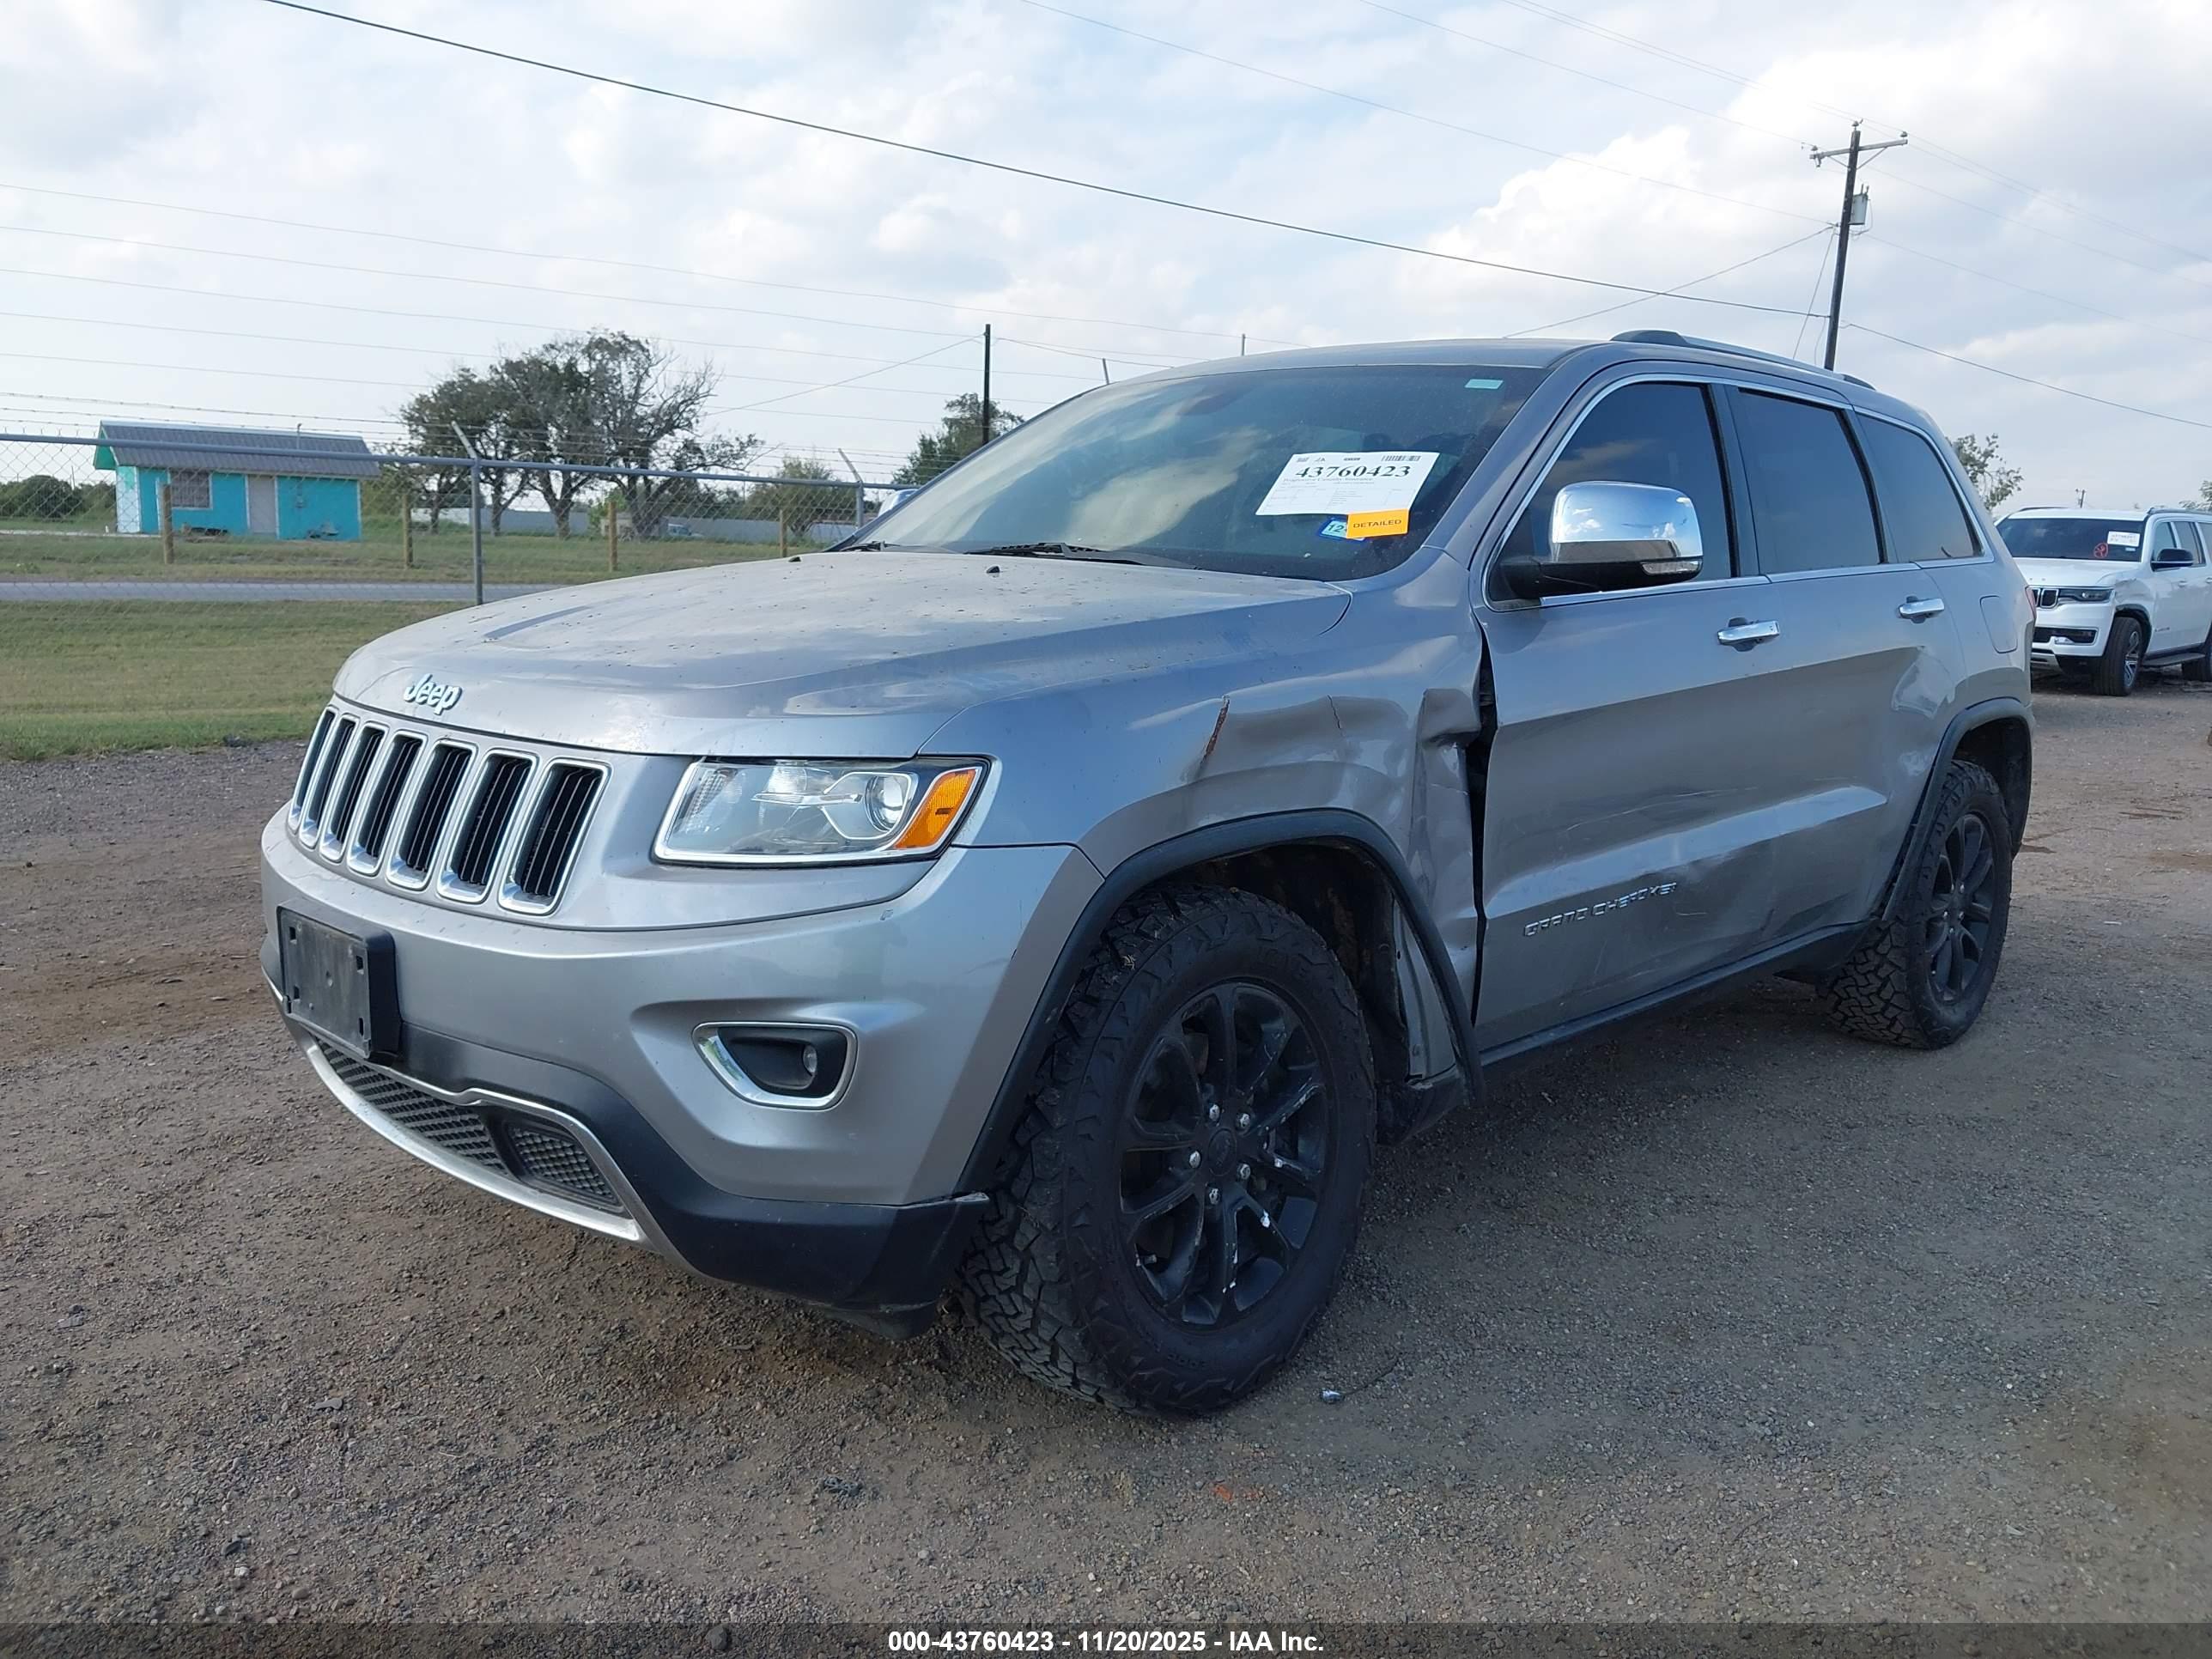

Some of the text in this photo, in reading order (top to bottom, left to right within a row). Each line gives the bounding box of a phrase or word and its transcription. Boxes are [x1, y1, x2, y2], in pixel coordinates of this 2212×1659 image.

[1296, 465, 1410, 477] 43760423
[1352, 519, 1402, 529] DETAILED
[404, 673, 463, 716] Jeep
